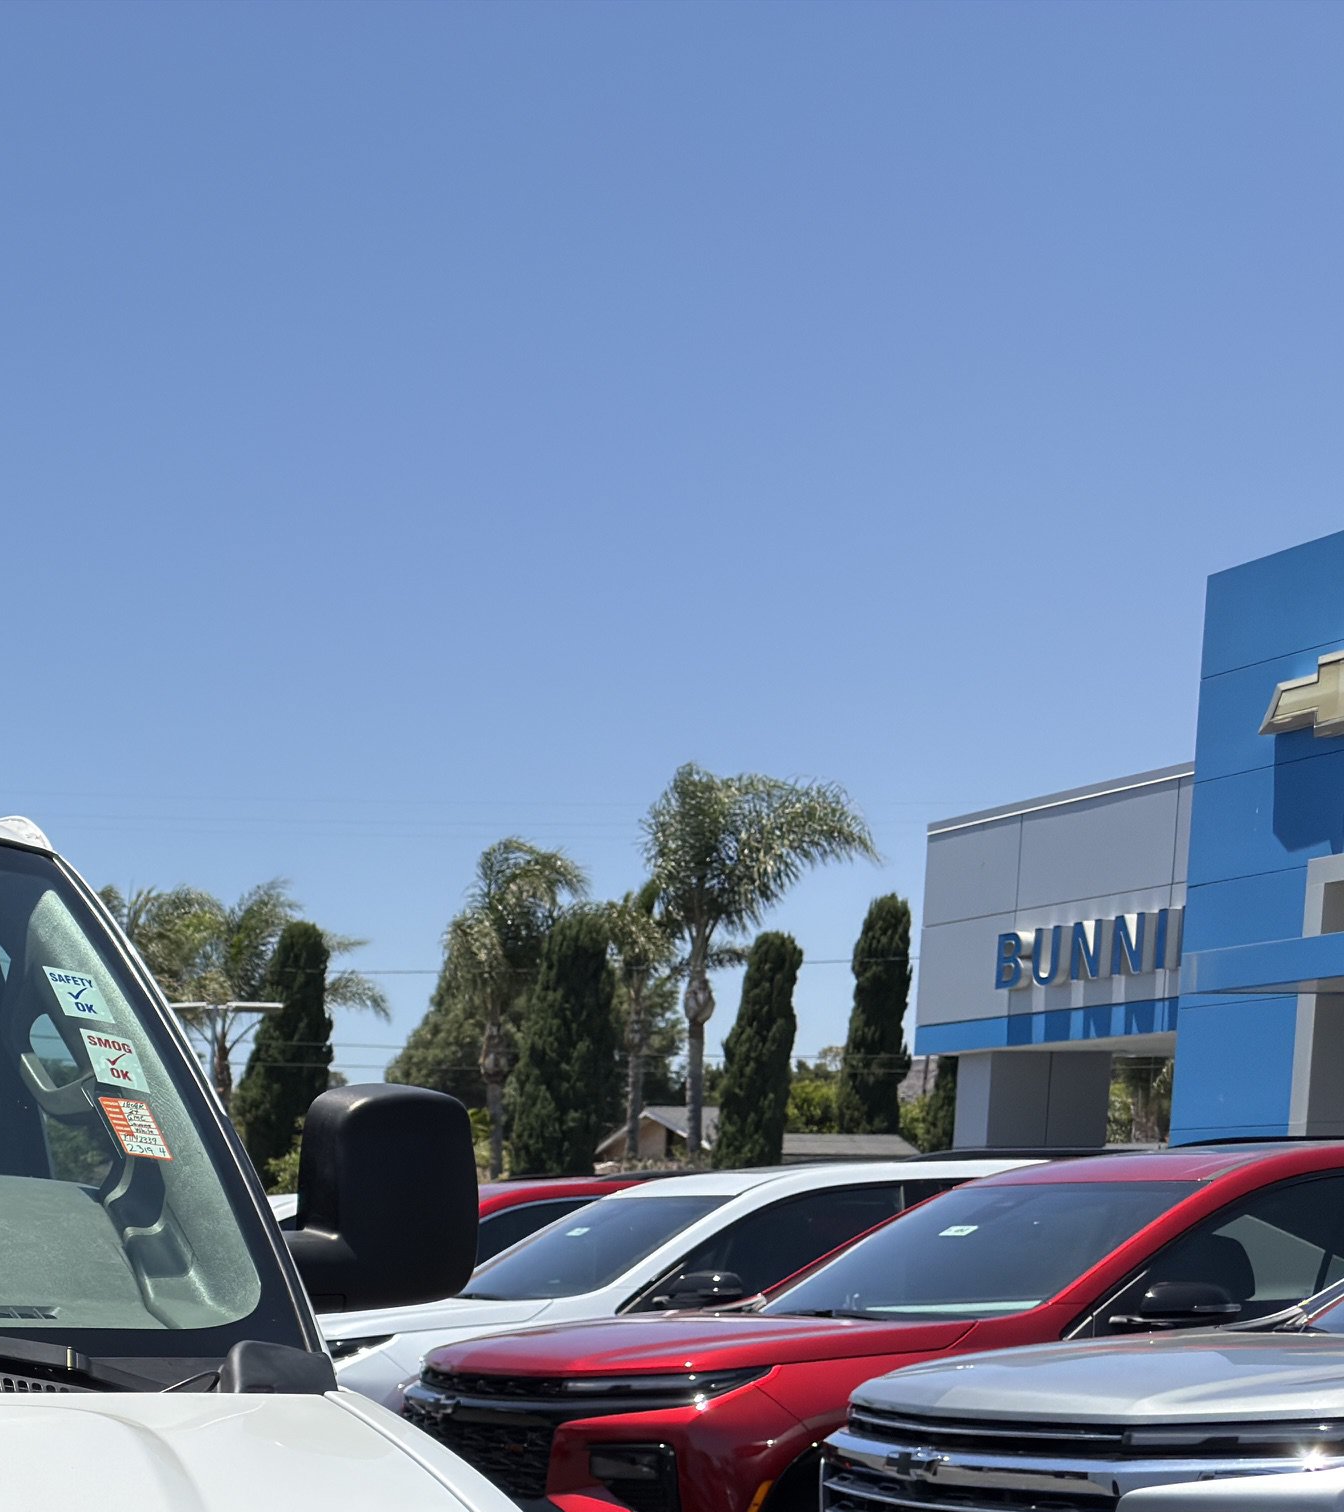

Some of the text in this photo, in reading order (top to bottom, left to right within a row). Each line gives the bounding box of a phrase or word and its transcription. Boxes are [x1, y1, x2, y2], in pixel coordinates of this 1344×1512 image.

[994, 906, 1185, 990] BUNNI
[49, 972, 93, 988] SAFETY
[74, 1001, 97, 1014] OK
[86, 1035, 132, 1054] SMOG
[109, 1067, 132, 1082] OK
